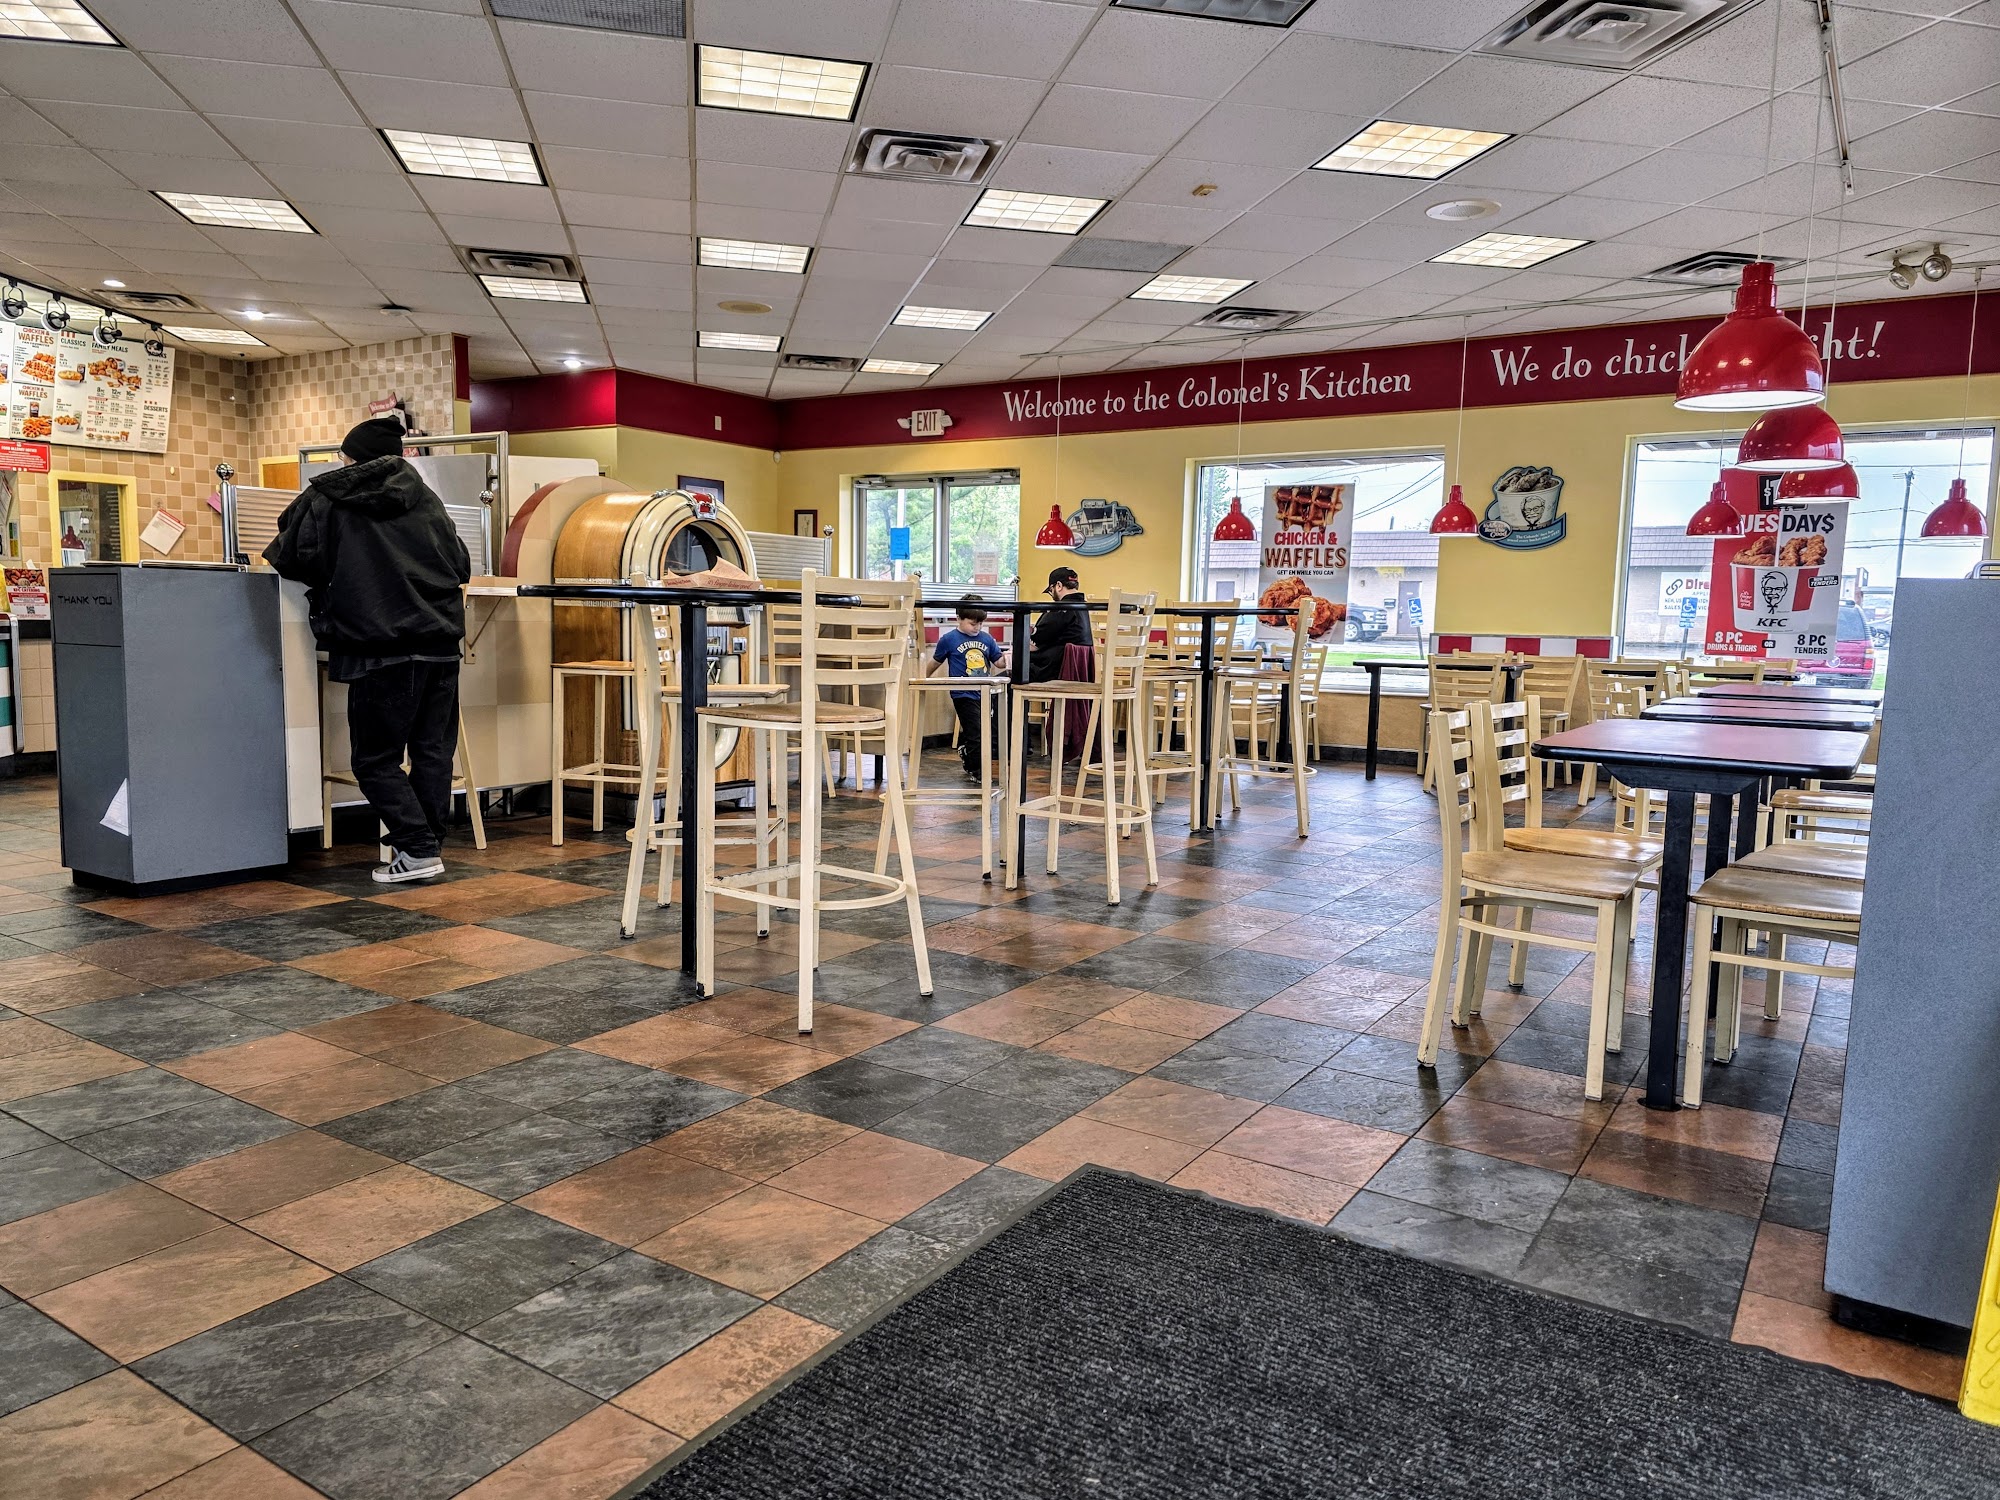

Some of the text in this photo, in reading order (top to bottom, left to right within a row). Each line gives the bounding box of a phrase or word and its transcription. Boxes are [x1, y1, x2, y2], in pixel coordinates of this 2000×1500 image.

[18, 332, 54, 345] WAFFLES
[60, 337, 87, 347] CLASSICS
[110, 345, 129, 353] MEALS
[1490, 345, 1540, 387] We
[1551, 346, 1592, 381] do
[1604, 333, 1693, 377] chick
[18, 389, 48, 399] WAFFLES
[1003, 362, 1412, 422] Welcome to the Colonel's Kitchen
[143, 405, 169, 413] DESSERTS
[916, 411, 938, 432] EXIT
[1741, 512, 1835, 534] UESDAY$
[1274, 531, 1338, 546] CHICKEN &
[1264, 547, 1347, 569] WAFFLES
[57, 595, 90, 605] THANK
[92, 595, 113, 606] YOU
[1756, 617, 1789, 627] KFC
[1714, 631, 1743, 644] 8 PC
[1797, 634, 1827, 646] 8 PC
[956, 640, 989, 654] DEFINITELY
[1706, 643, 1728, 651] DRUMS
[1735, 644, 1757, 653] THIGHS
[1793, 646, 1828, 655] TENDERS
